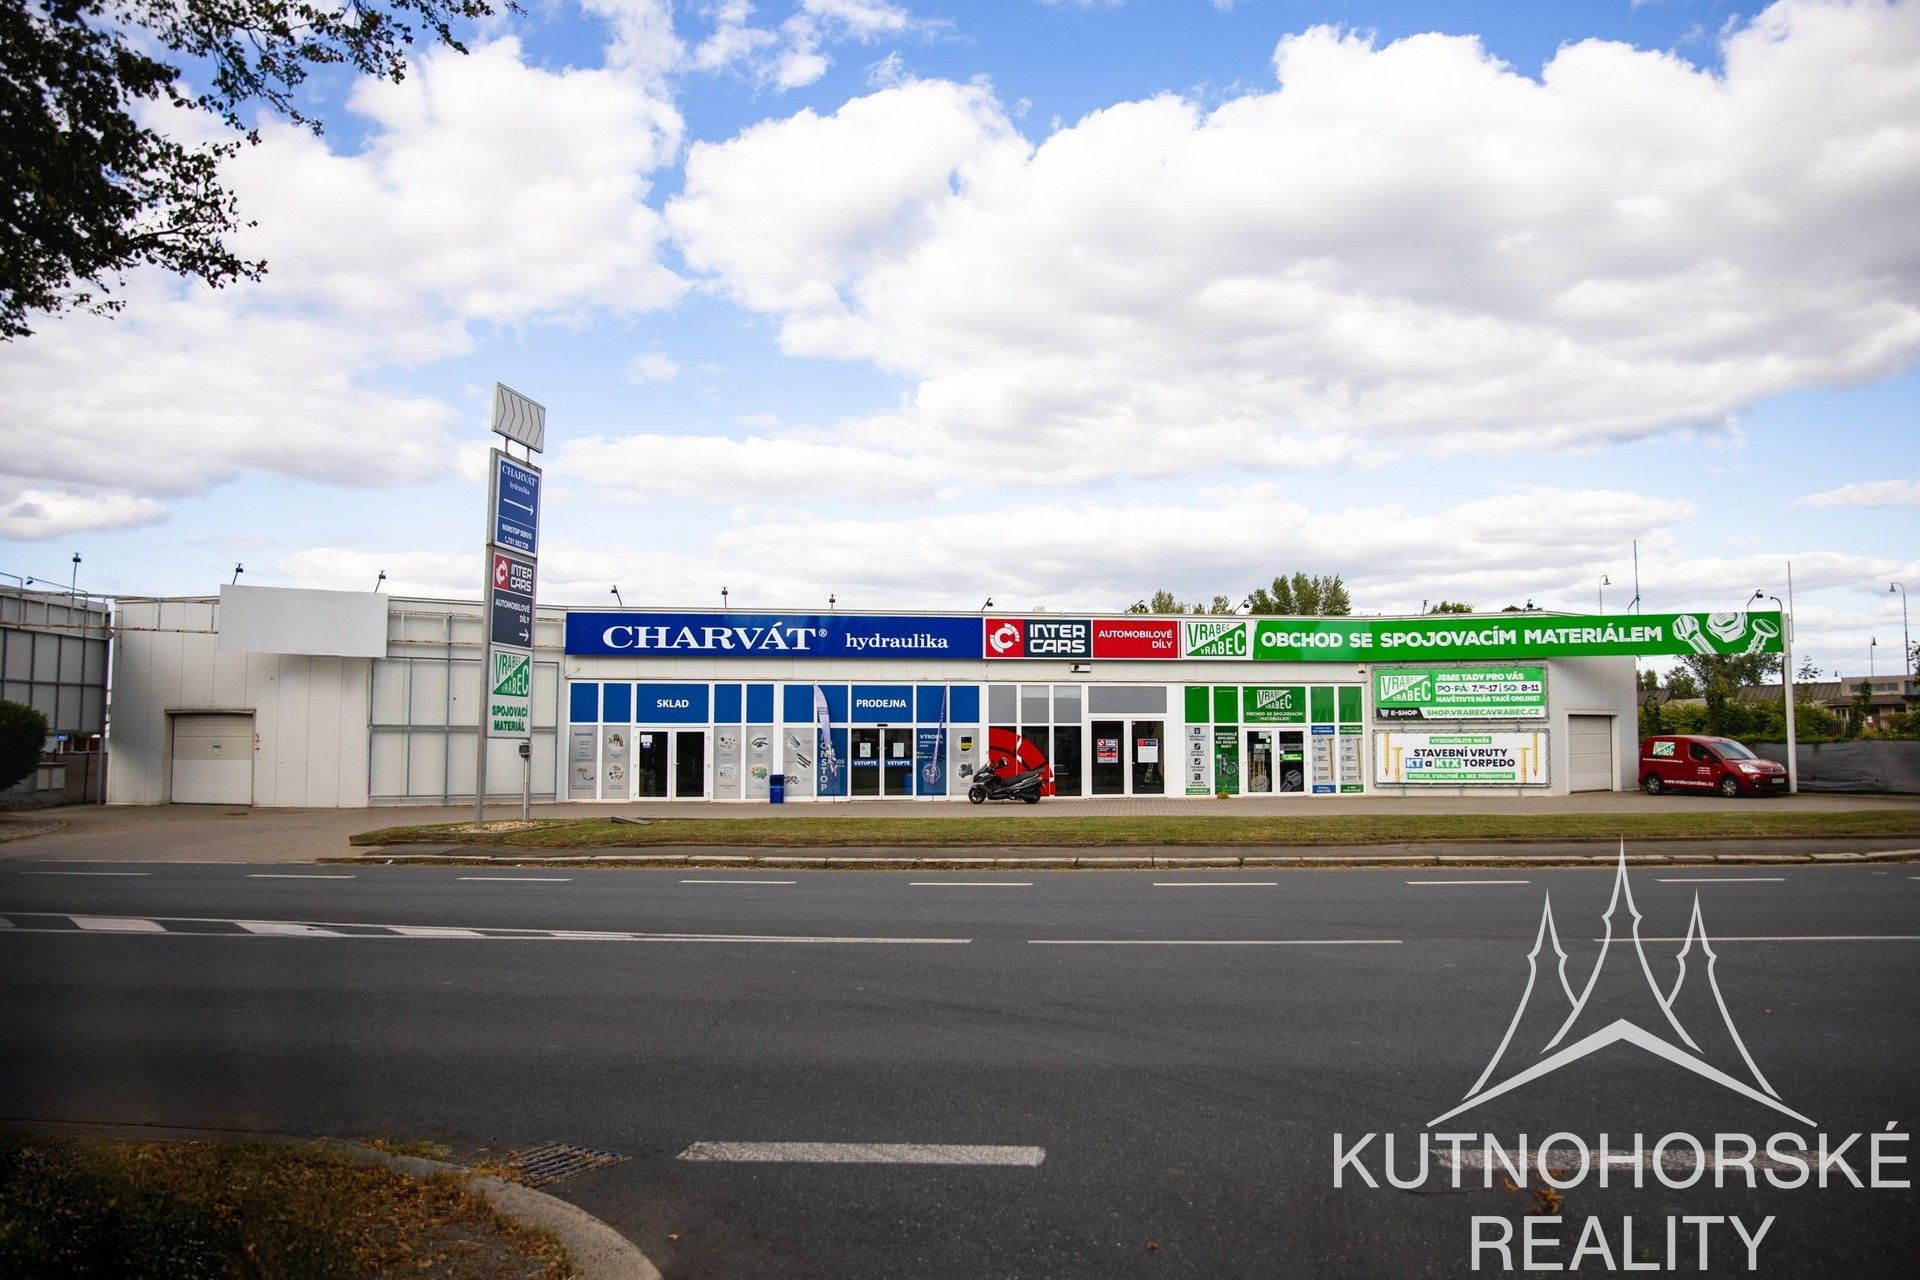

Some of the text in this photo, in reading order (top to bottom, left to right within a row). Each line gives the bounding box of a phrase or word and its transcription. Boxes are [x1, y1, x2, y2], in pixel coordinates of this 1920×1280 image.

[502, 465, 537, 487] CHARVÁT
[509, 481, 530, 495] hydraulika
[511, 563, 532, 580] INTER
[510, 576, 532, 593] CARS
[495, 598, 530, 613] AUTOMOBILOVÉ
[519, 614, 530, 624] DÍLY
[1029, 623, 1086, 639] INTER
[1098, 629, 1173, 639] AUTOMOBILOVÉ
[1261, 622, 1663, 648] OBCHOD SE SPOJOVACÍM MATERIÁLEM
[845, 632, 949, 650] hydraulika
[1029, 639, 1086, 654] CARS
[1151, 639, 1173, 649] DÍLY
[1436, 671, 1524, 681] JSME TADY PRO VÁS
[1521, 684, 1539, 692] 8-11
[656, 699, 690, 708] SKLAD
[856, 699, 907, 708] PRODEJNA
[491, 704, 528, 717] SPOJOVACÍ
[1426, 707, 1540, 716] SHOP.VRABECAVRABEC.CZ
[494, 718, 525, 732] MATERIÁL
[1413, 746, 1508, 757] STAVEBNÍ VRUTY
[1406, 758, 1423, 768] KT
[1435, 758, 1460, 768] KTX
[1463, 758, 1516, 767] TORPEDO
